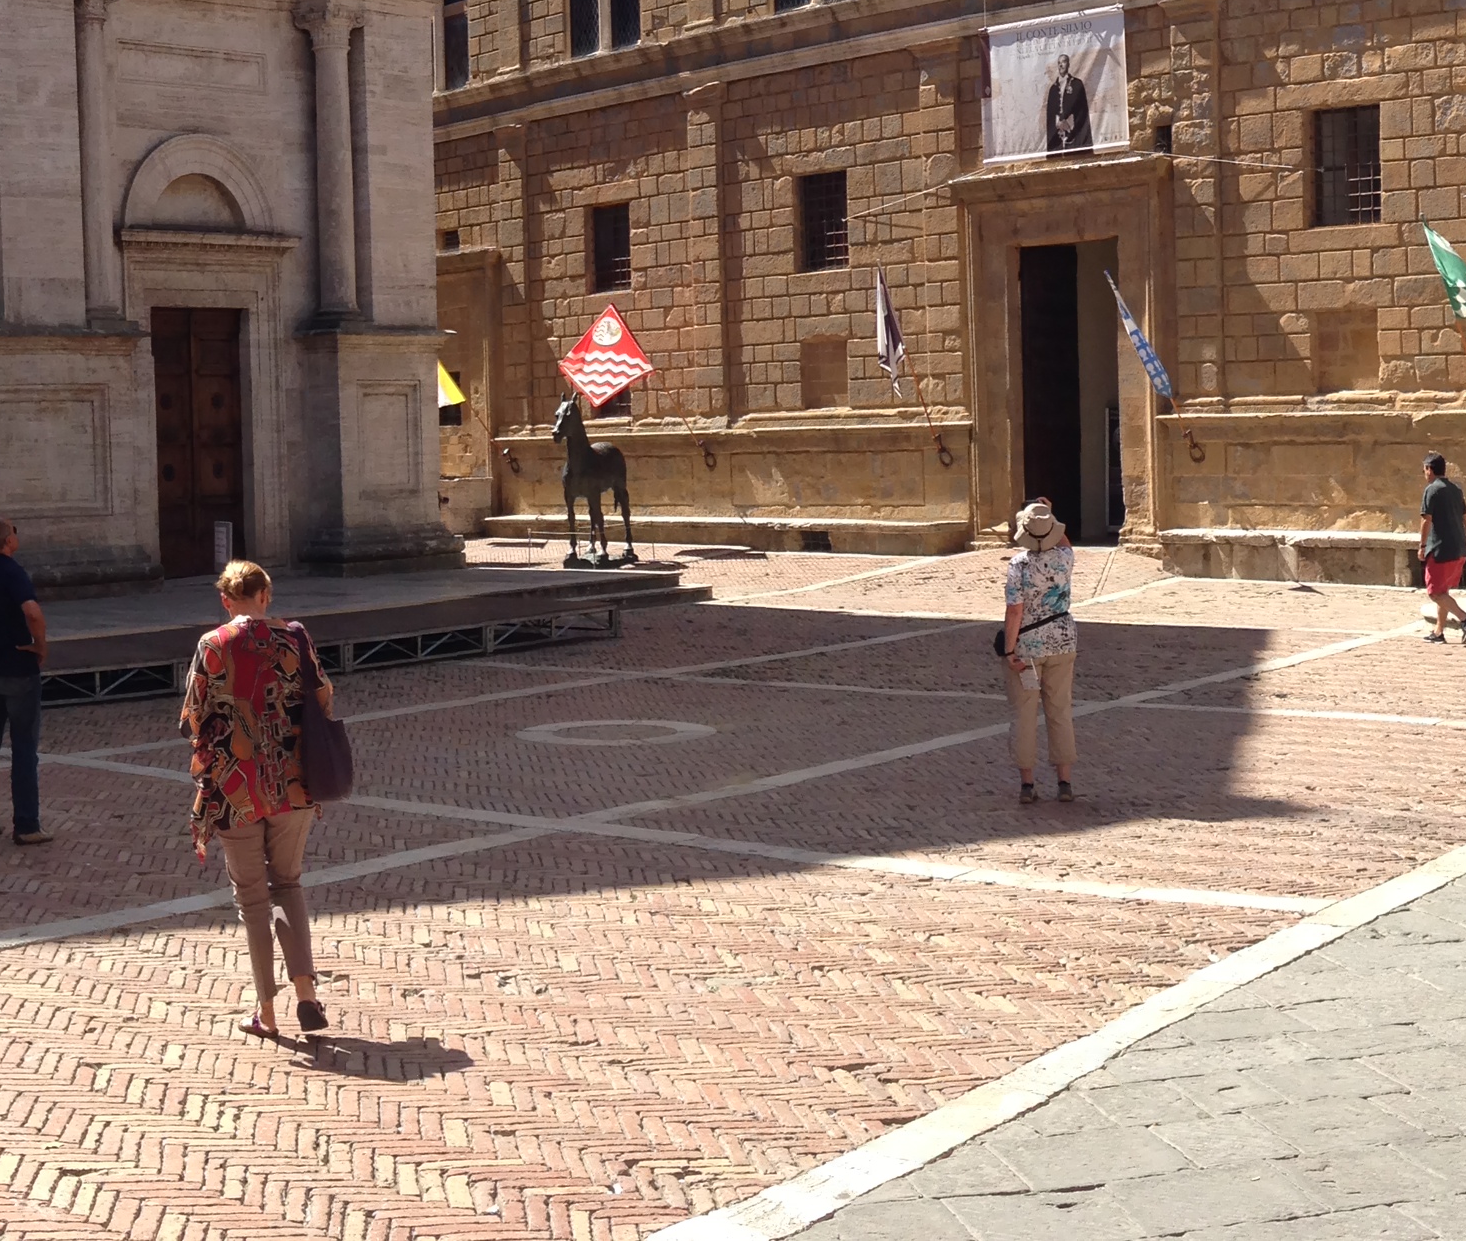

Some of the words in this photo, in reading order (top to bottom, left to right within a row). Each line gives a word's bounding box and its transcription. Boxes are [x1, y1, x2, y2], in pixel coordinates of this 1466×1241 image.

[1016, 32, 1023, 42] IL
[1026, 26, 1058, 39] CONTE
[1061, 20, 1092, 34] SILVIO
